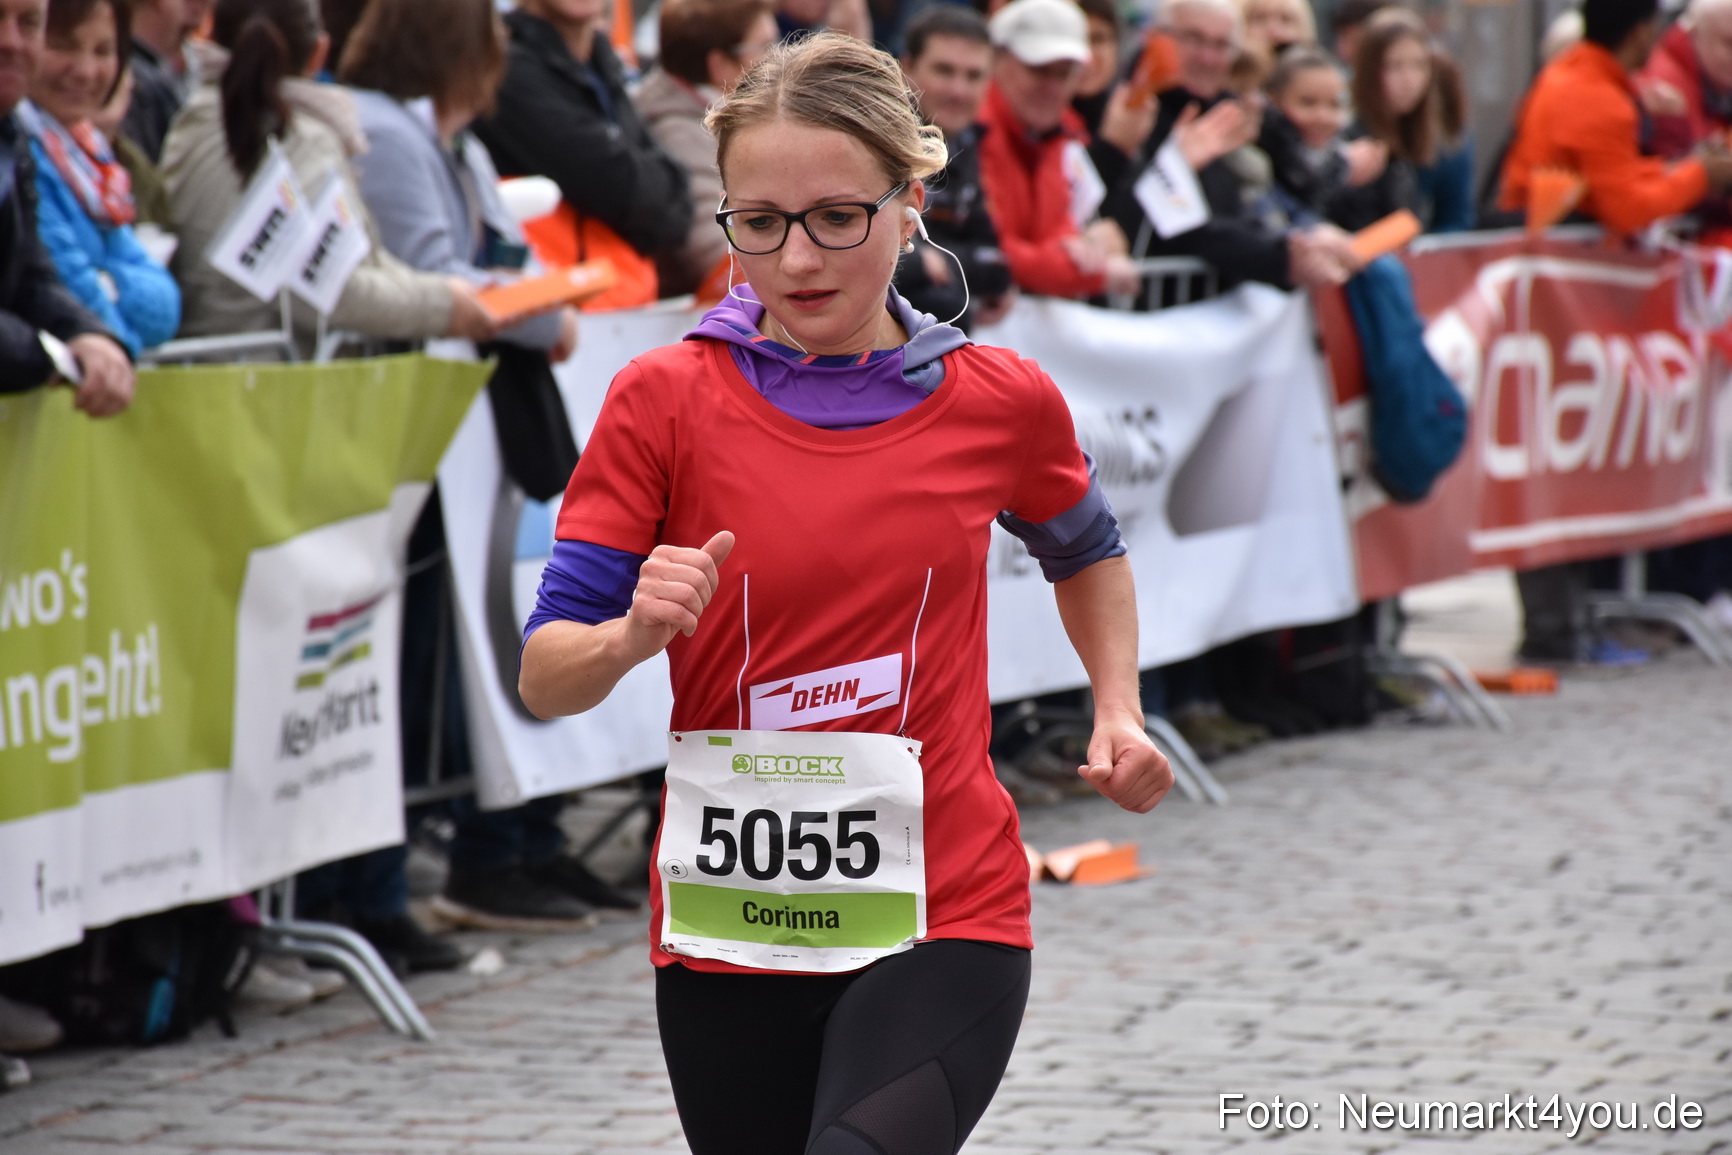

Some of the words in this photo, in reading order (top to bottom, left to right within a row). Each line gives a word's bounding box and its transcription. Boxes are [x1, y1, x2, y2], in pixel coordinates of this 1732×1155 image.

[0, 620, 161, 764] ngeht!
[791, 678, 860, 713] DEHN
[754, 755, 845, 777] BOCK
[754, 775, 782, 784] inspired
[783, 775, 792, 784] by
[815, 777, 846, 785] concepts
[696, 806, 880, 881] 5055
[671, 865, 680, 875] S
[743, 901, 840, 929] Corinna
